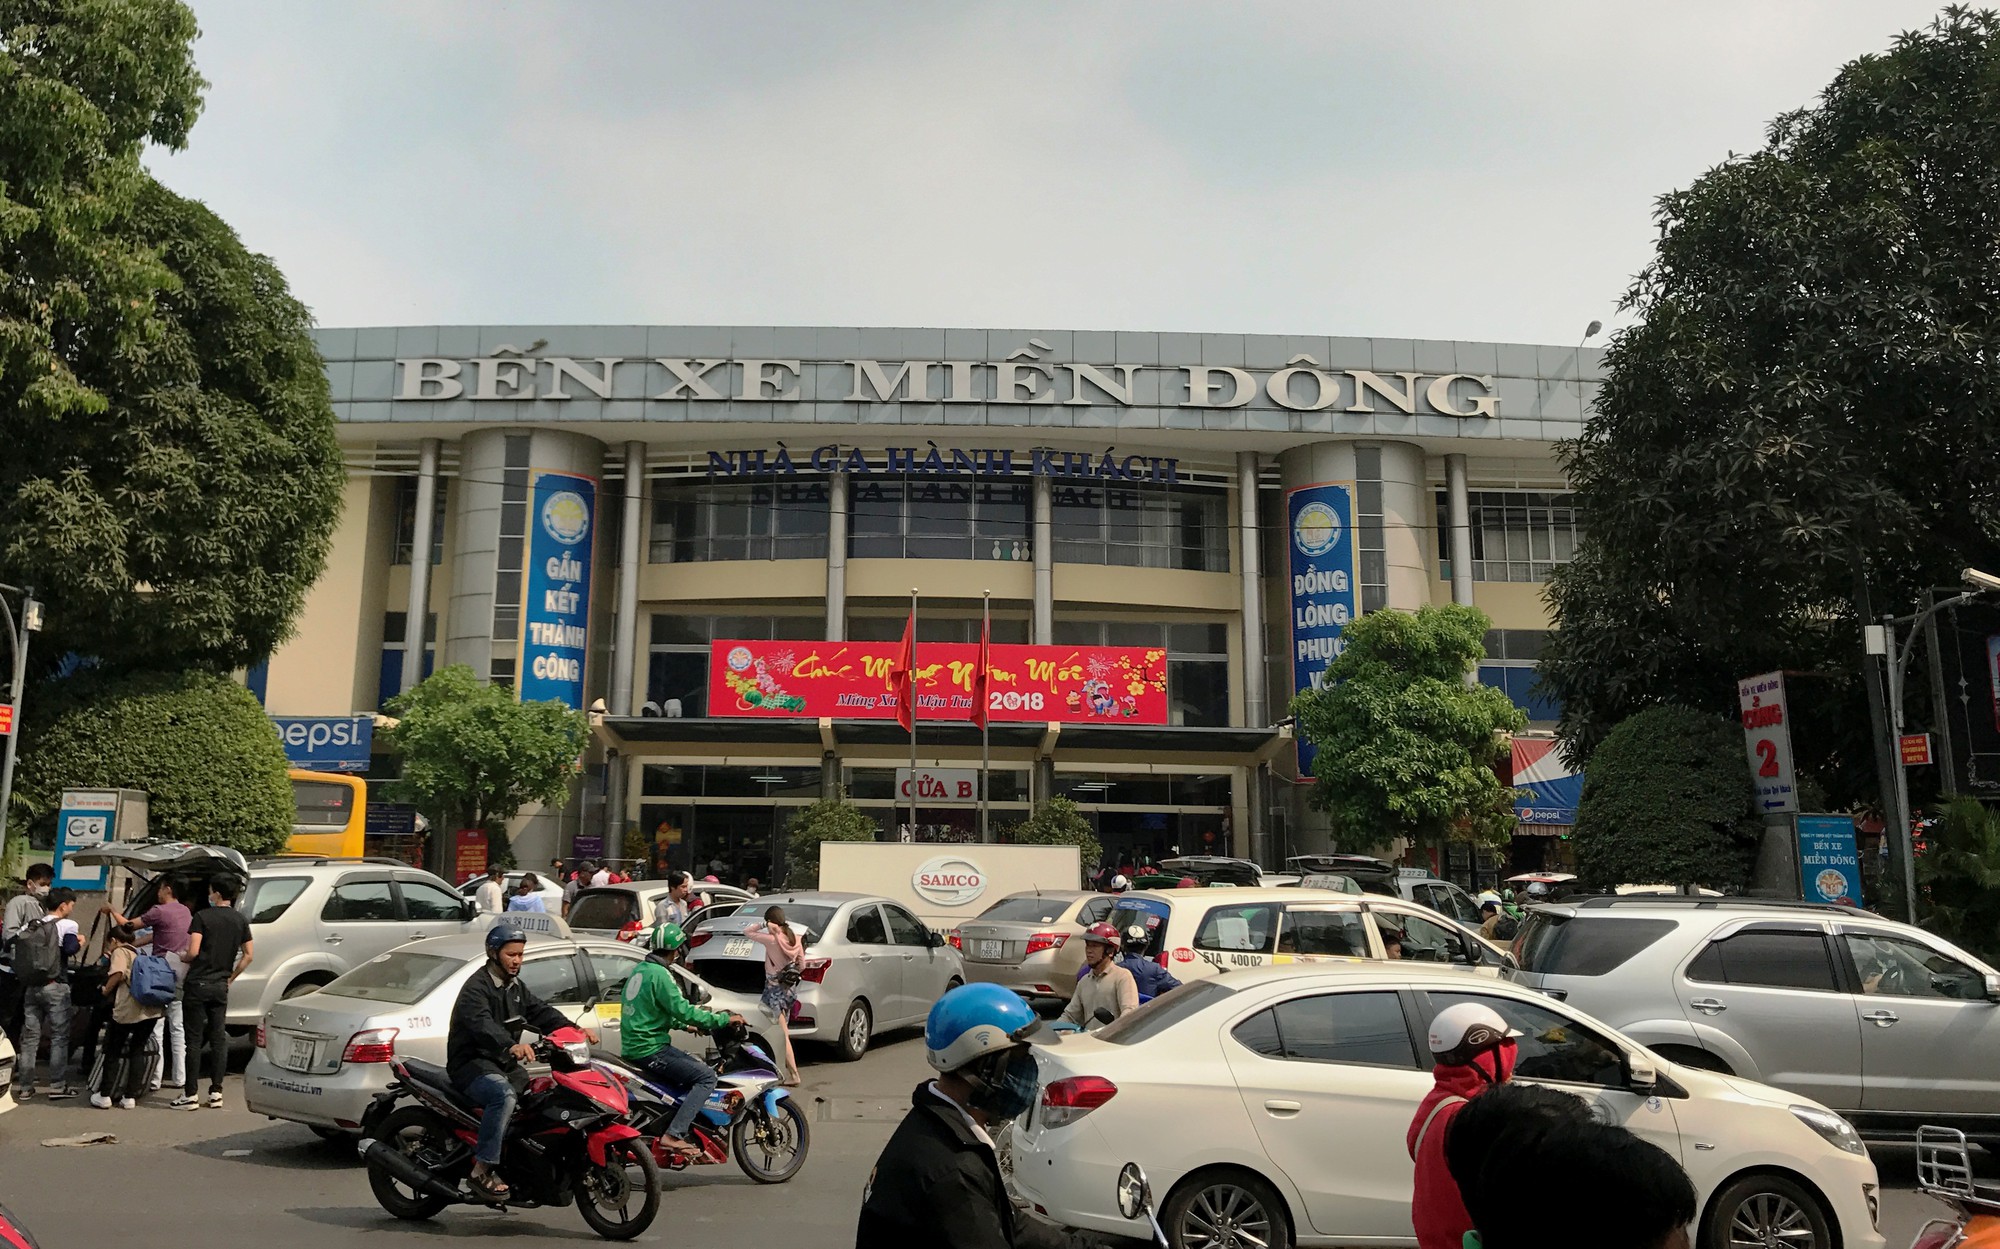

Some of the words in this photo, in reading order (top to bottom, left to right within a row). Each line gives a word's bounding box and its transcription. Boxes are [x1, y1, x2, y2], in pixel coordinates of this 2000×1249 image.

[396, 338, 622, 401] BẾN
[653, 358, 801, 402] XE
[843, 337, 1143, 405] MIỀN
[1179, 353, 1502, 418] ĐÔNG
[706, 440, 797, 476] NHÀ
[811, 446, 871, 473] GA
[885, 440, 1015, 476] HÀNH
[1029, 446, 1179, 484] KHÁCH
[1295, 564, 1348, 596] ĐỒNG
[545, 583, 580, 615] KẾT
[1296, 600, 1348, 629] LÒNG
[530, 618, 585, 650] THÀNH
[532, 652, 580, 682] CÔNG
[836, 693, 876, 709] Mừng
[1756, 739, 1779, 778] 2
[901, 774, 948, 798] CỬA
[957, 781, 973, 798] B
[1535, 811, 1560, 820] pepsi
[1813, 839, 1829, 850] BẾN
[1831, 842, 1842, 850] XE
[919, 874, 980, 888] SAMCO
[1173, 948, 1195, 962] 6599
[1203, 951, 1223, 966] 51A
[407, 1016, 432, 1029] 3710
